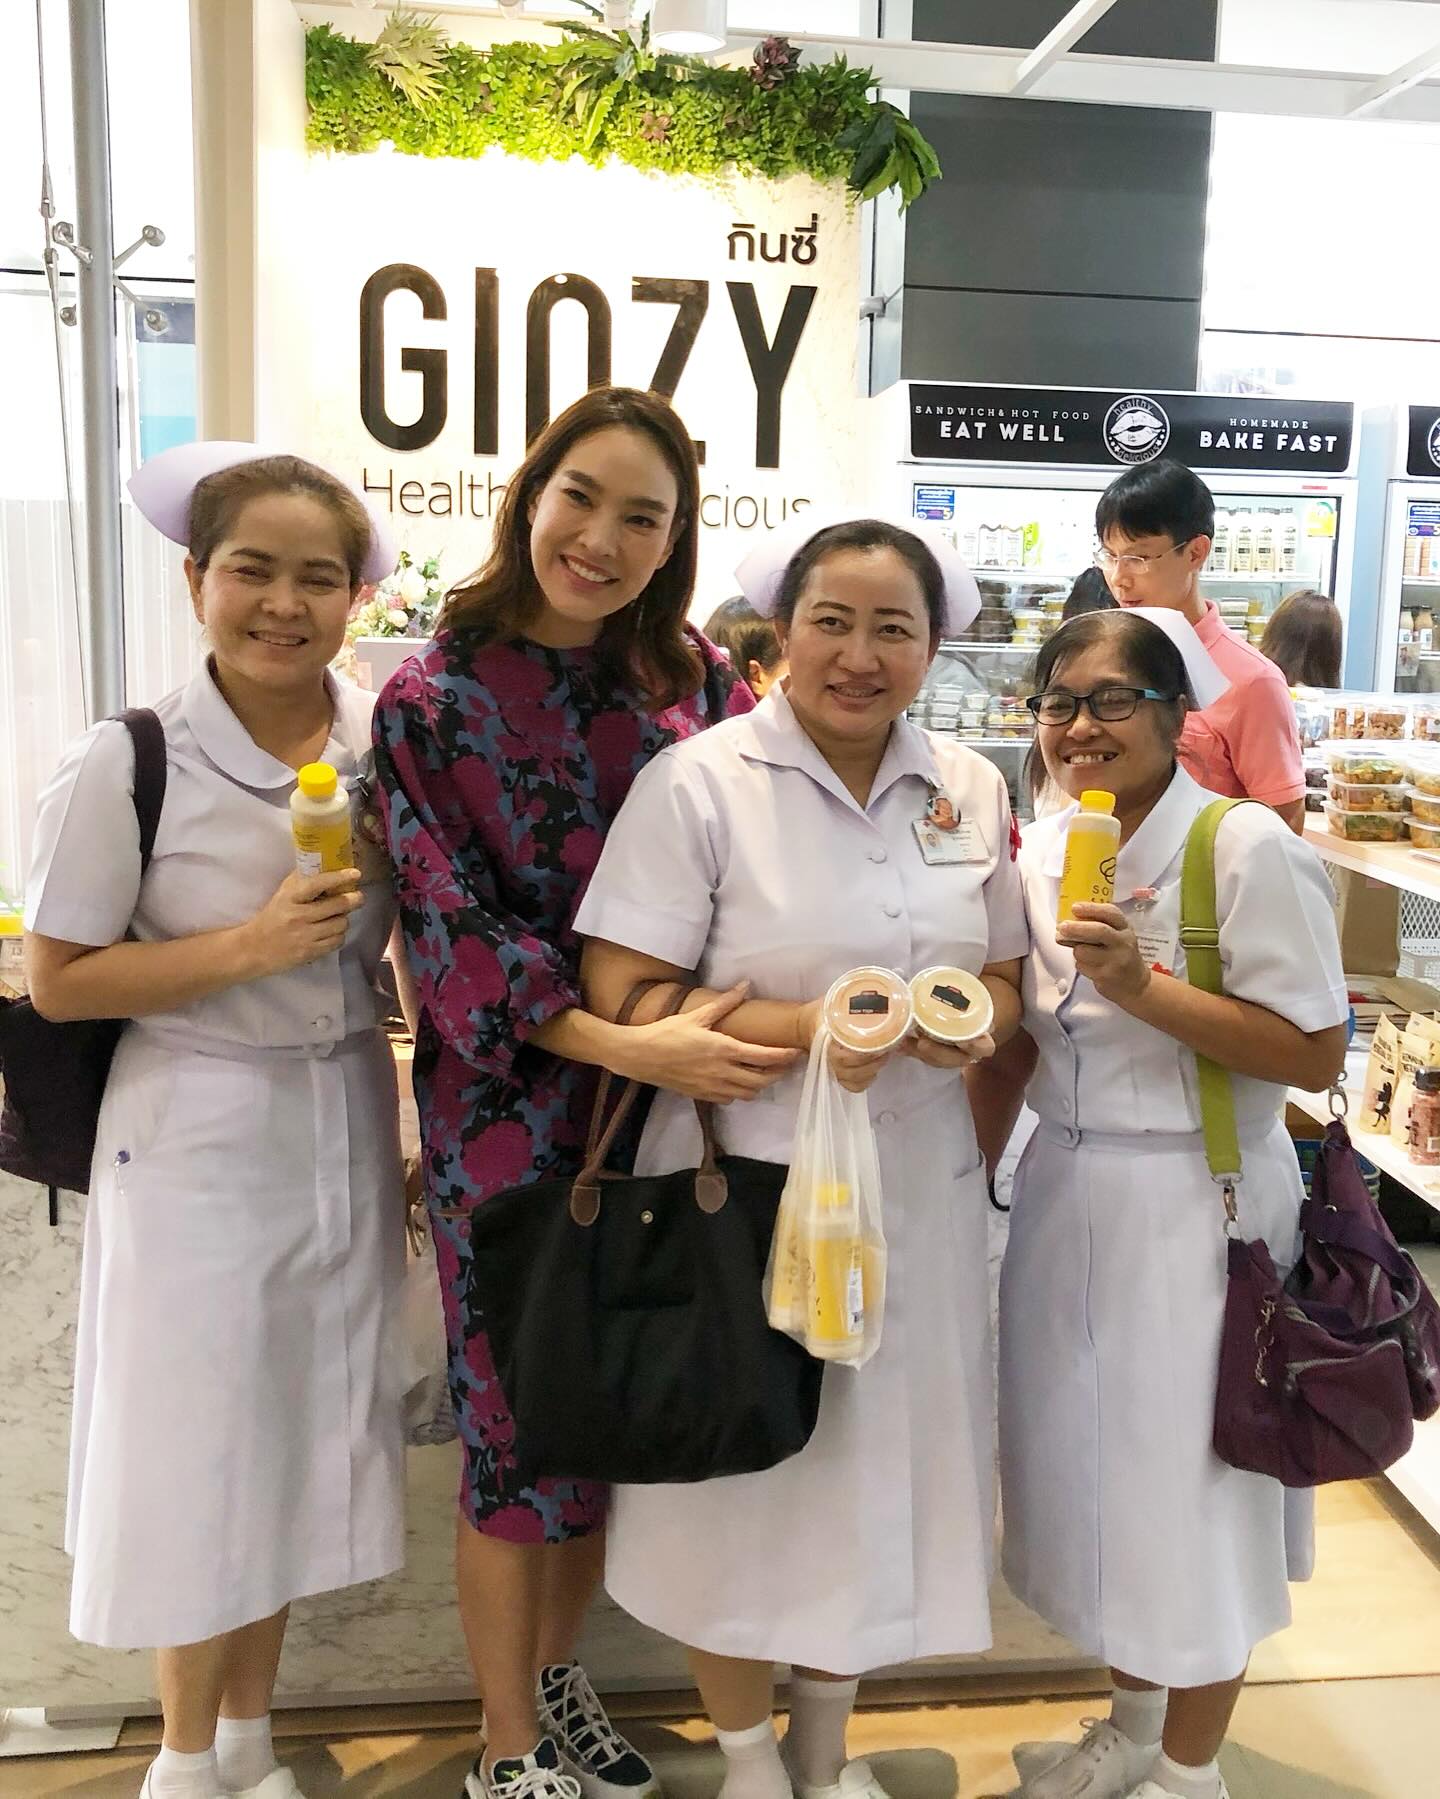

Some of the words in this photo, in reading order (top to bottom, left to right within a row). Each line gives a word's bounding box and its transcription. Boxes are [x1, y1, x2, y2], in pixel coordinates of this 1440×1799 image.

[727, 212, 818, 265] กินซี่
[1011, 409, 1040, 419] HOT
[1052, 411, 1090, 421] FOOD
[1229, 418, 1309, 430] HOMEMADE
[940, 421, 987, 440] EAT
[999, 423, 1065, 443] WELL
[1199, 430, 1264, 451] BAKE
[1276, 433, 1338, 453] FAST
